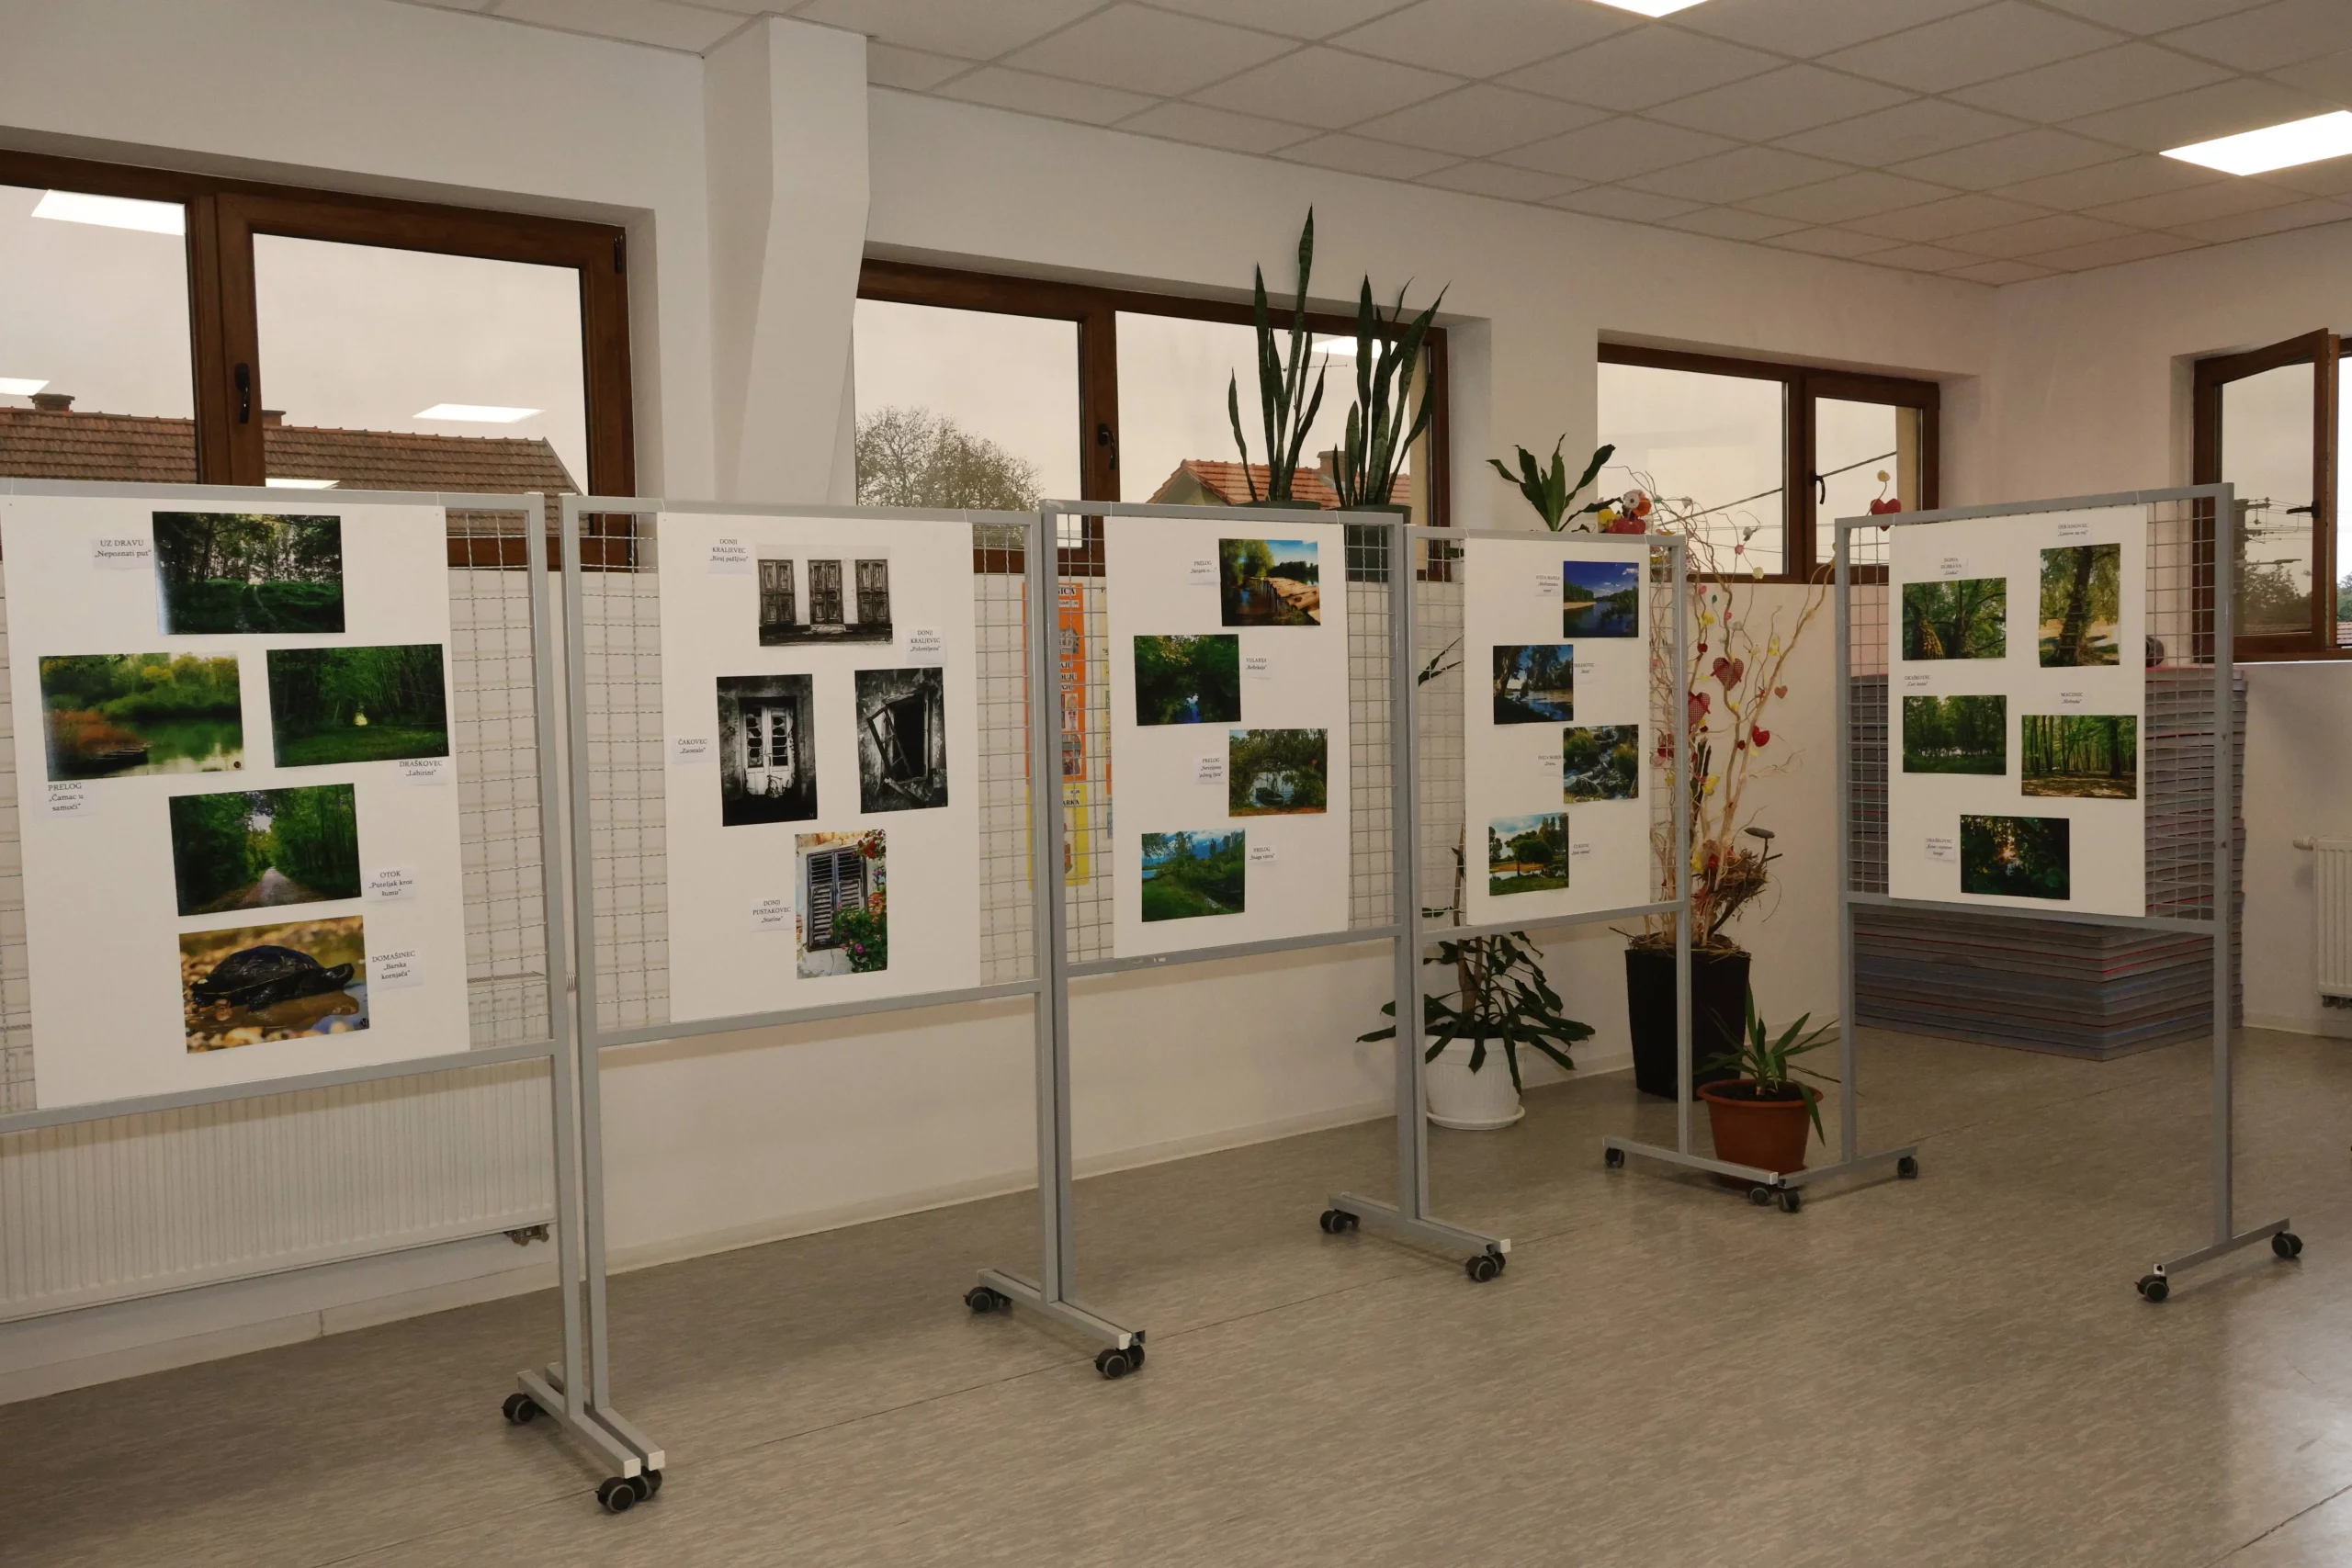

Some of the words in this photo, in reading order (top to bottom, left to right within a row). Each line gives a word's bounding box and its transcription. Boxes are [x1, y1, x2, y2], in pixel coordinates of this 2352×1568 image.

[48, 782, 82, 791] PRELOG
[752, 907, 791, 915] PUSTAKOVEC
[372, 950, 415, 963] DOMAŠINEC
